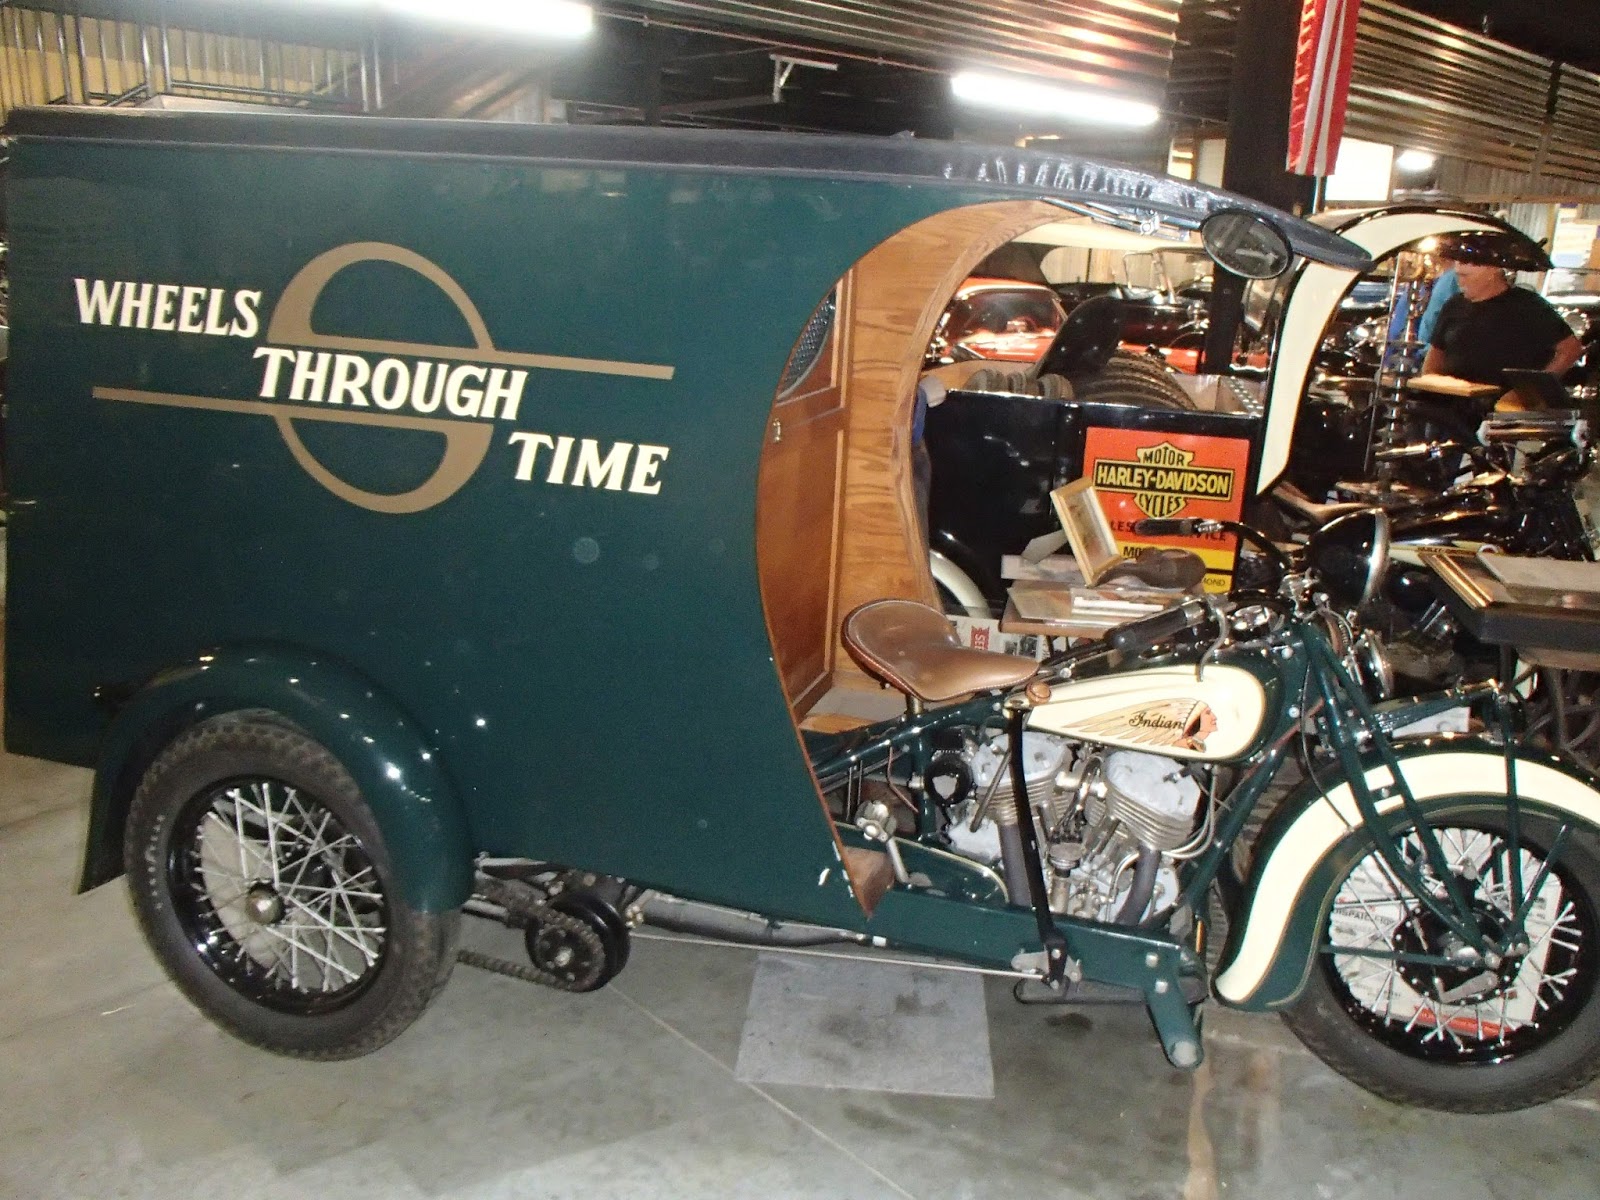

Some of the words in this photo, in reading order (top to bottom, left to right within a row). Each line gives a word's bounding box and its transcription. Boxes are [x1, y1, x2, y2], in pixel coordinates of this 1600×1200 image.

[74, 278, 262, 338] WHEELS
[253, 346, 529, 421] THROUGH
[508, 431, 670, 495] TIME
[1143, 446, 1185, 467] MOTOR
[1098, 465, 1230, 495] HARLEY-DAVIDSON
[1138, 493, 1183, 519] CYCLES
[1129, 711, 1184, 730] Indian
